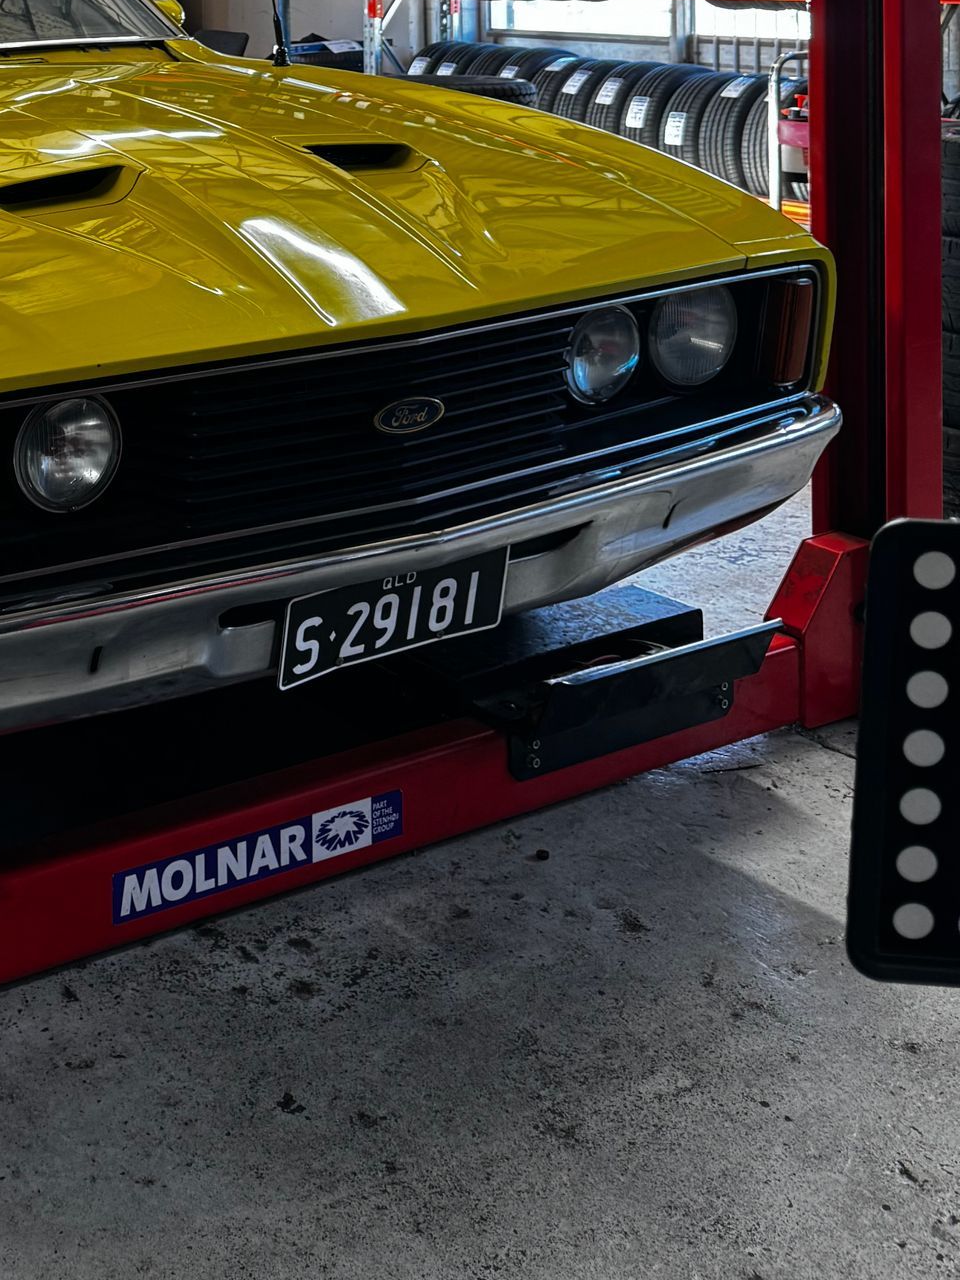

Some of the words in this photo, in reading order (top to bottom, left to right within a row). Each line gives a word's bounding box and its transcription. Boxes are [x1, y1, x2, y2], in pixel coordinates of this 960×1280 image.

[391, 404, 429, 428] Ford
[382, 571, 417, 590] QLD
[373, 800, 387, 810] PART
[373, 810, 381, 818] OF
[381, 807, 393, 816] THE
[373, 822, 394, 834] GROUP
[119, 824, 307, 918] MOLNAR
